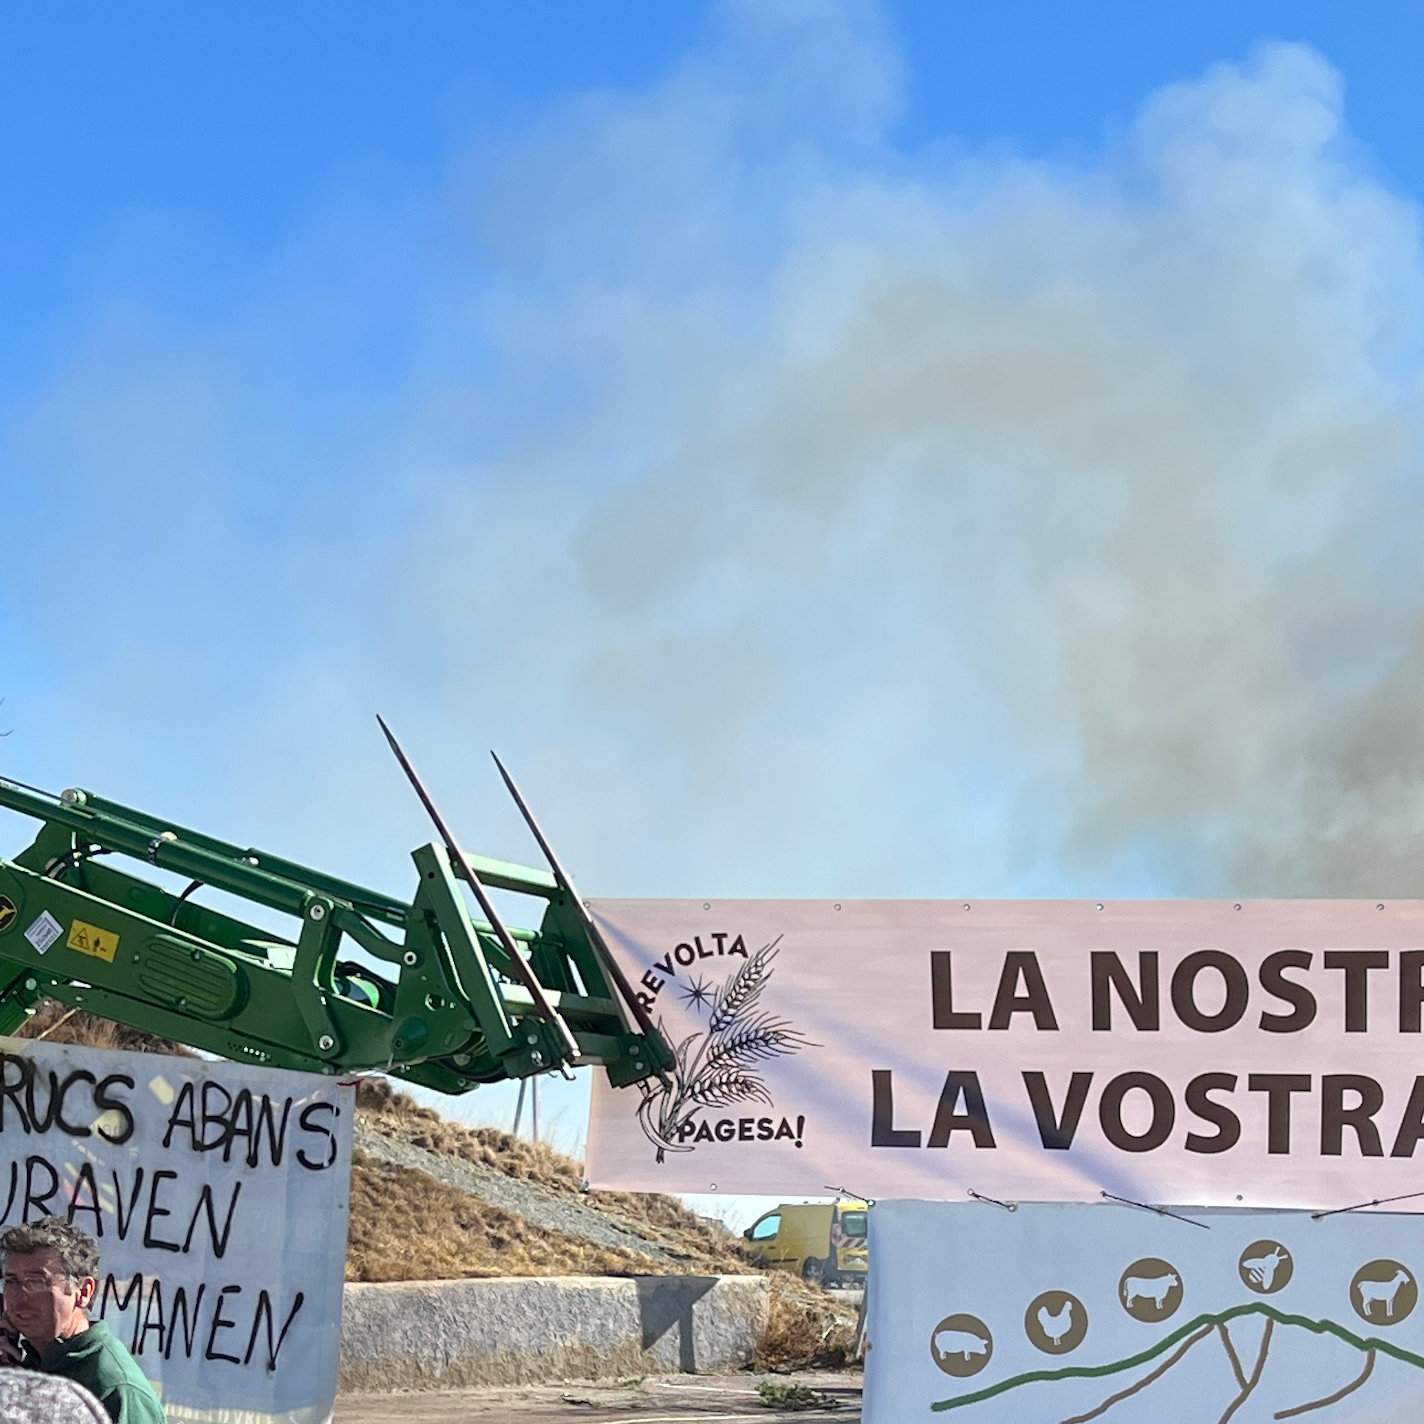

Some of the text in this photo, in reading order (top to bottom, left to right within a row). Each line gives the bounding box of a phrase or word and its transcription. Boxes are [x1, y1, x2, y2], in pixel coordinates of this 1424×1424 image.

[637, 932, 748, 1014] REVOLTA
[931, 950, 1061, 1031] LA
[162, 1081, 341, 1170] ABANS
[678, 1115, 806, 1149] PAGESA!
[871, 1069, 997, 1149] LA
